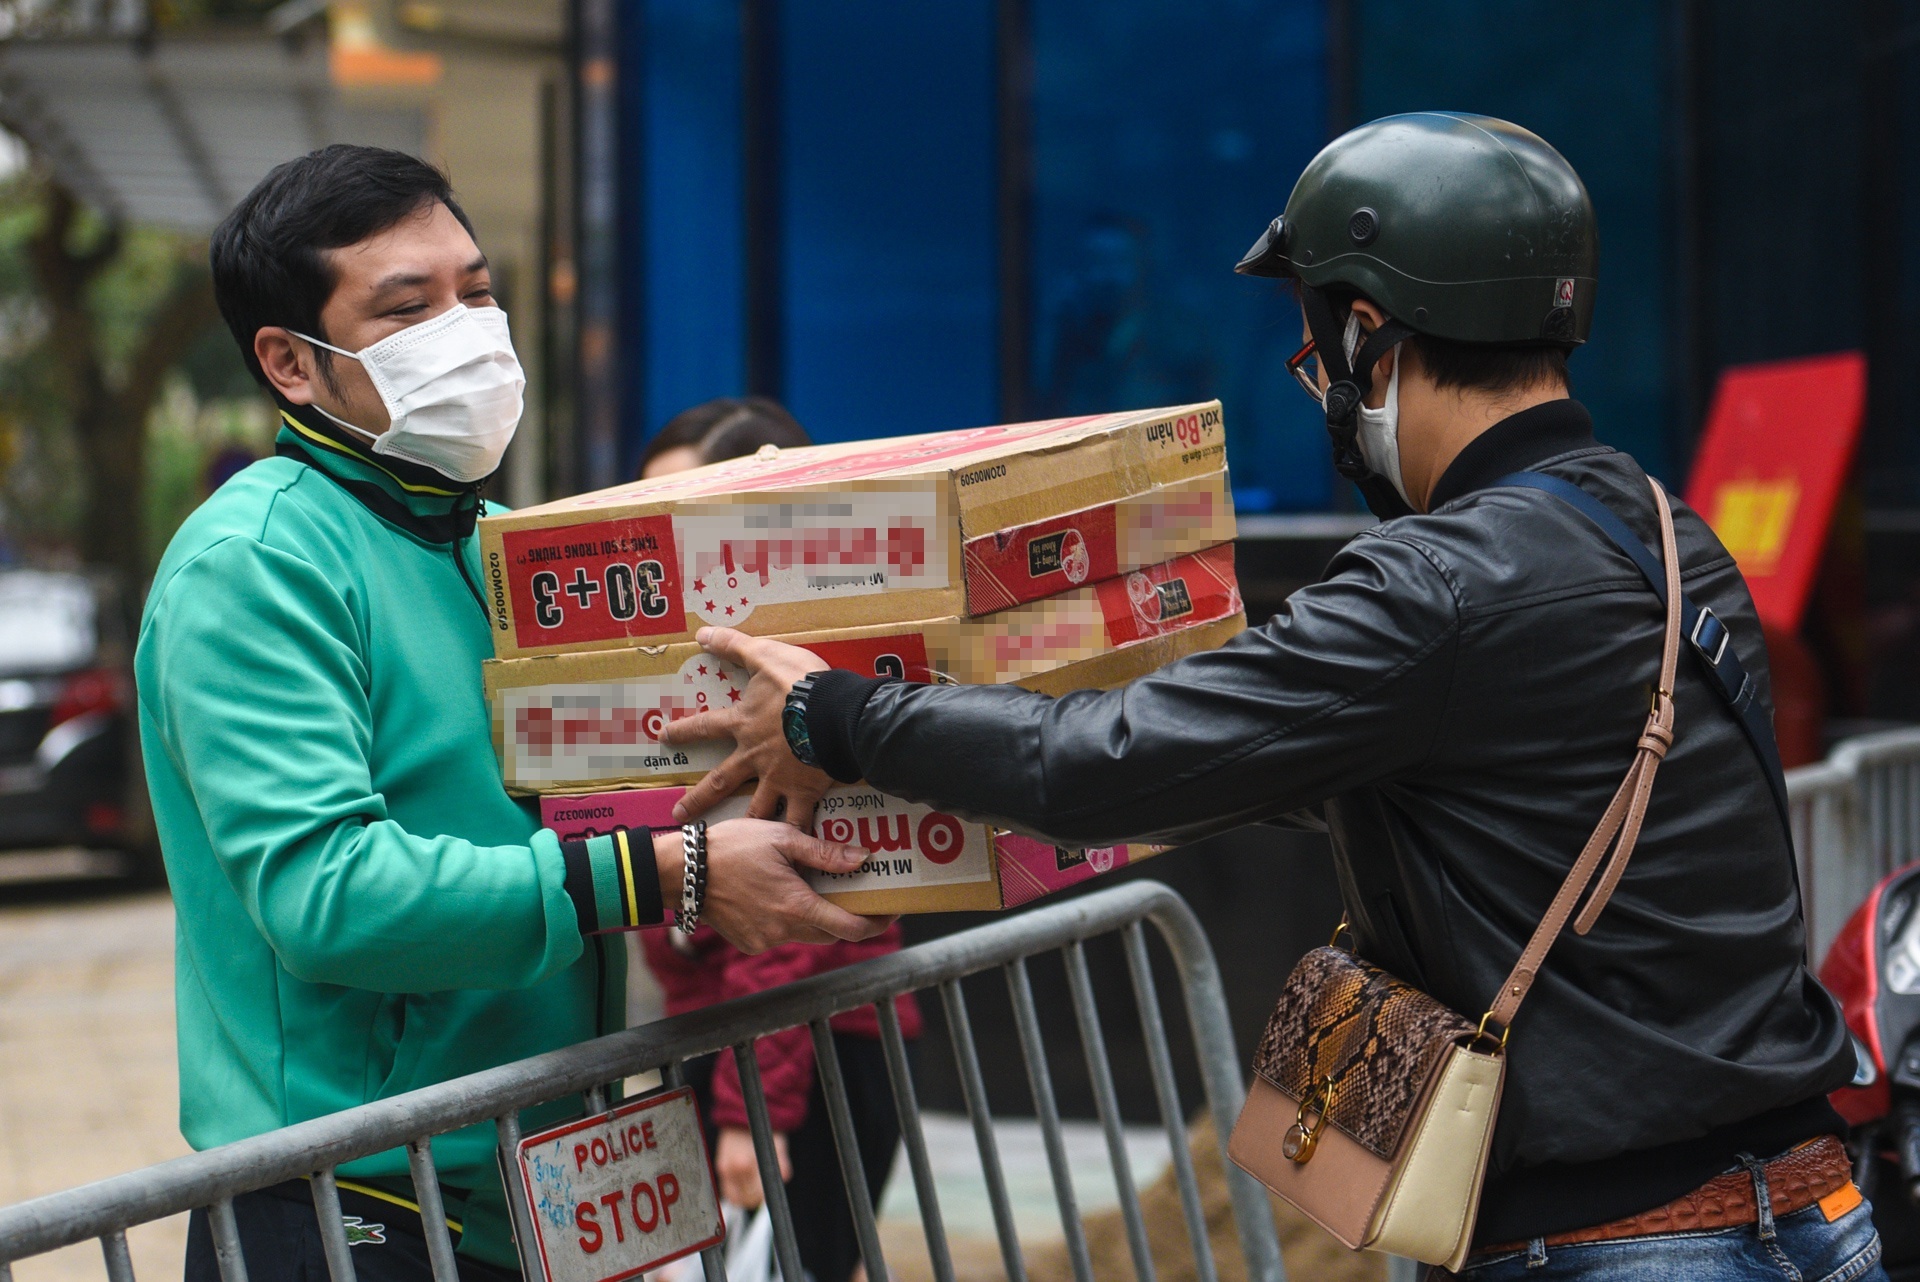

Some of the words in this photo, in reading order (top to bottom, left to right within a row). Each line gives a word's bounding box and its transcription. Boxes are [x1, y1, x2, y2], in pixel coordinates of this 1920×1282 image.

[1176, 414, 1201, 449] Bò
[1200, 409, 1220, 437] xốt
[1146, 421, 1175, 449] hầm
[528, 545, 564, 566] THÙNG
[565, 541, 599, 559] TRONG
[672, 751, 690, 766] đà
[823, 796, 844, 815] cốt
[848, 793, 885, 811] Nước
[553, 806, 615, 822] 02OM00327
[848, 859, 891, 877] kho
[896, 858, 913, 876] Mì
[573, 1121, 657, 1173] POLICE
[575, 1172, 680, 1254] STOP
